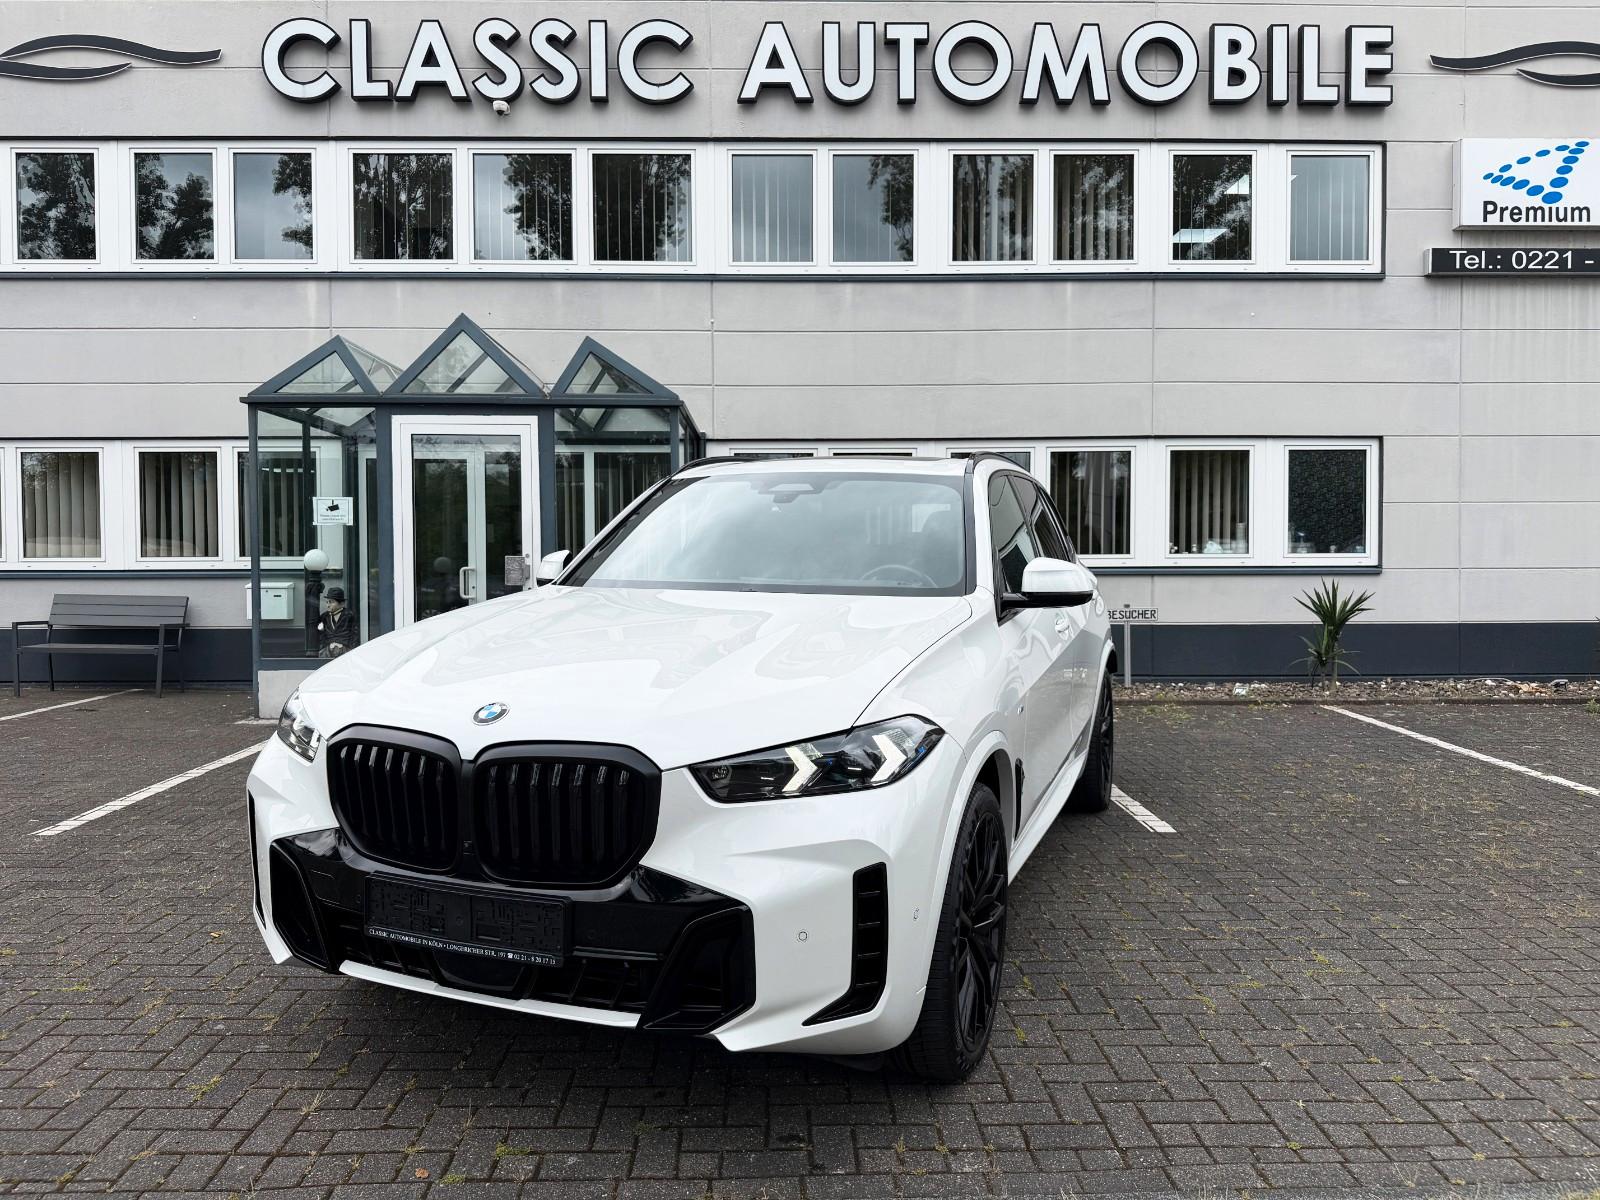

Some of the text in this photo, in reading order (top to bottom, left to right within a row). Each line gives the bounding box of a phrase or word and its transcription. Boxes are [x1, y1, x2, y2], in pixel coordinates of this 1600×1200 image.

[261, 17, 1394, 108] CLASSIC AUTOMOBILE
[1482, 200, 1591, 223] Premium
[1449, 250, 1501, 269] Tel.:
[1511, 250, 1573, 269] 0221
[368, 928, 389, 938] CLASSIC
[389, 933, 421, 944] AUTOMOBILE
[428, 940, 443, 948] KÖLN
